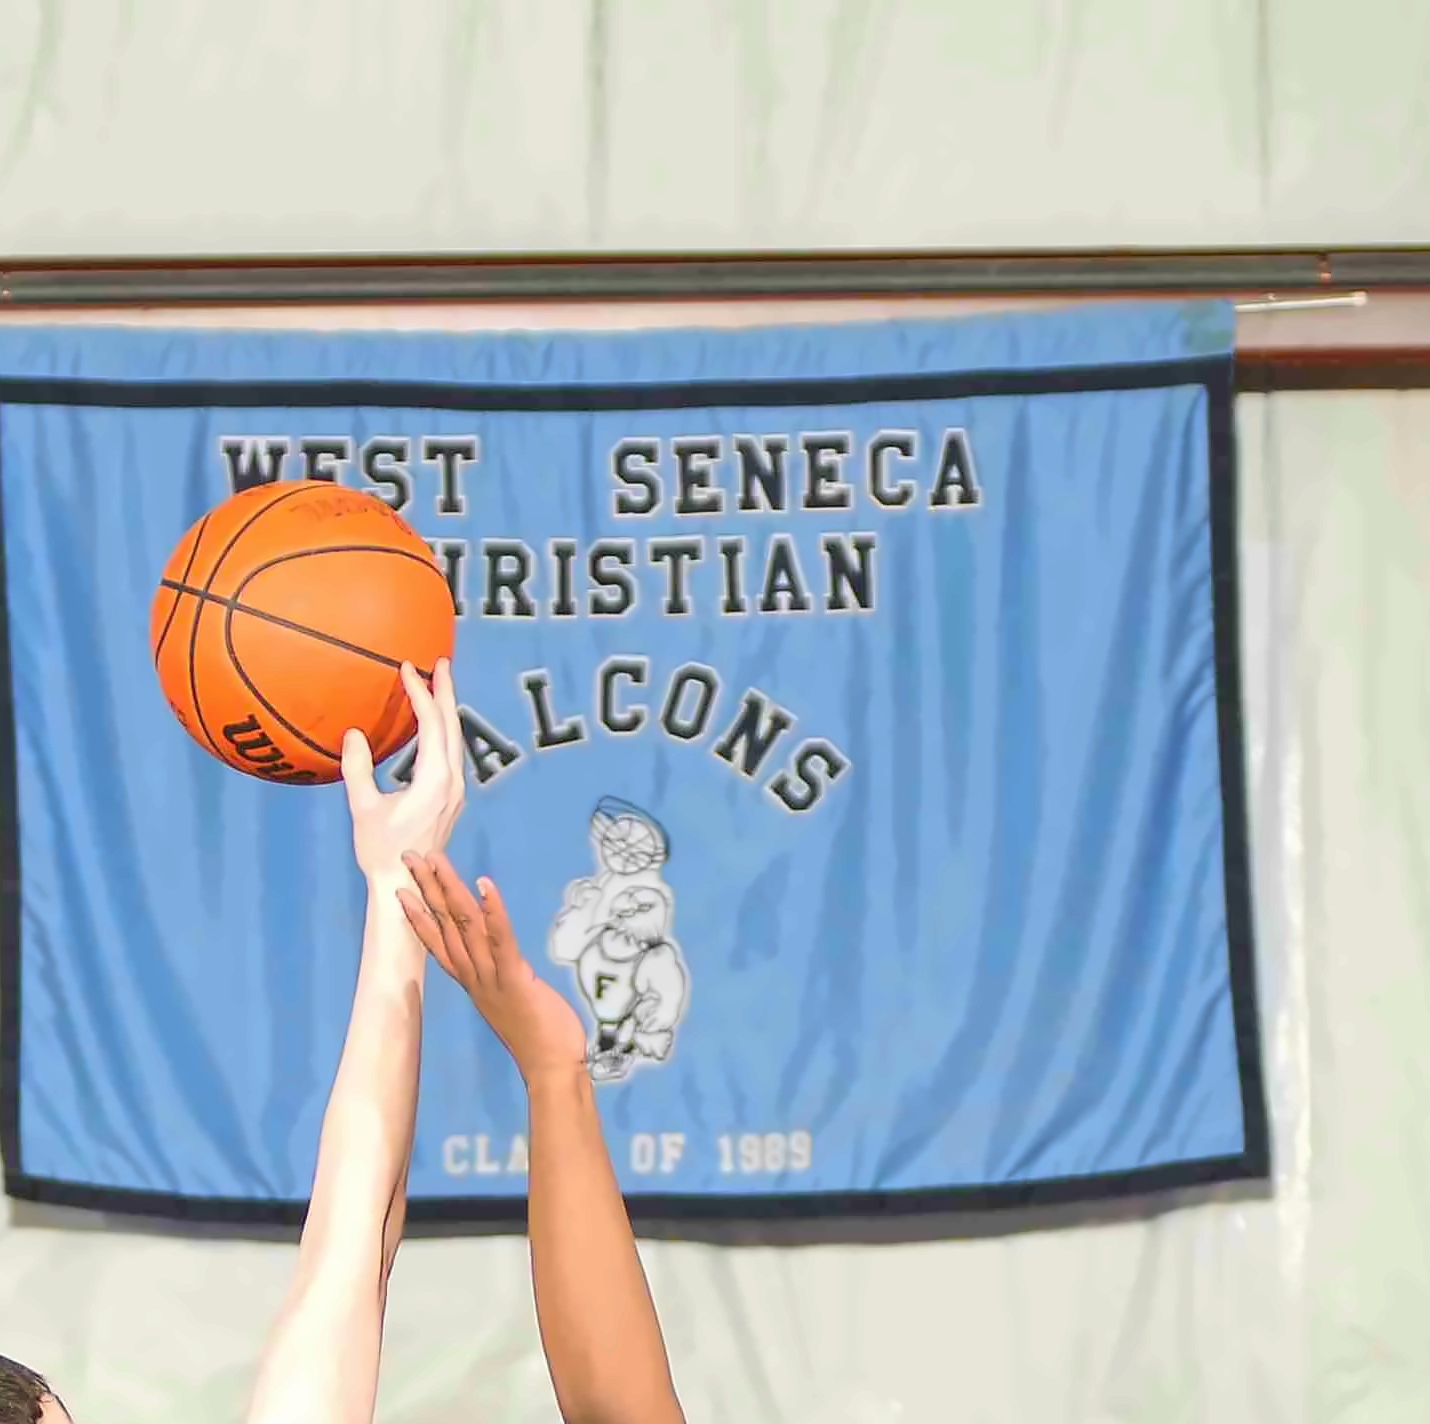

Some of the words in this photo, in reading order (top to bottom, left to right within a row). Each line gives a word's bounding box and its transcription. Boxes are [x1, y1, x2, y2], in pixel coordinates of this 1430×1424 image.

[218, 434, 479, 515] WEST
[612, 428, 980, 517] SENECA
[423, 534, 876, 618] RISTIAN
[391, 655, 851, 813] ALCONS
[595, 973, 618, 1000] F
[442, 1134, 528, 1174] CLA
[630, 1132, 686, 1174] OF
[716, 1130, 812, 1174] 1989
